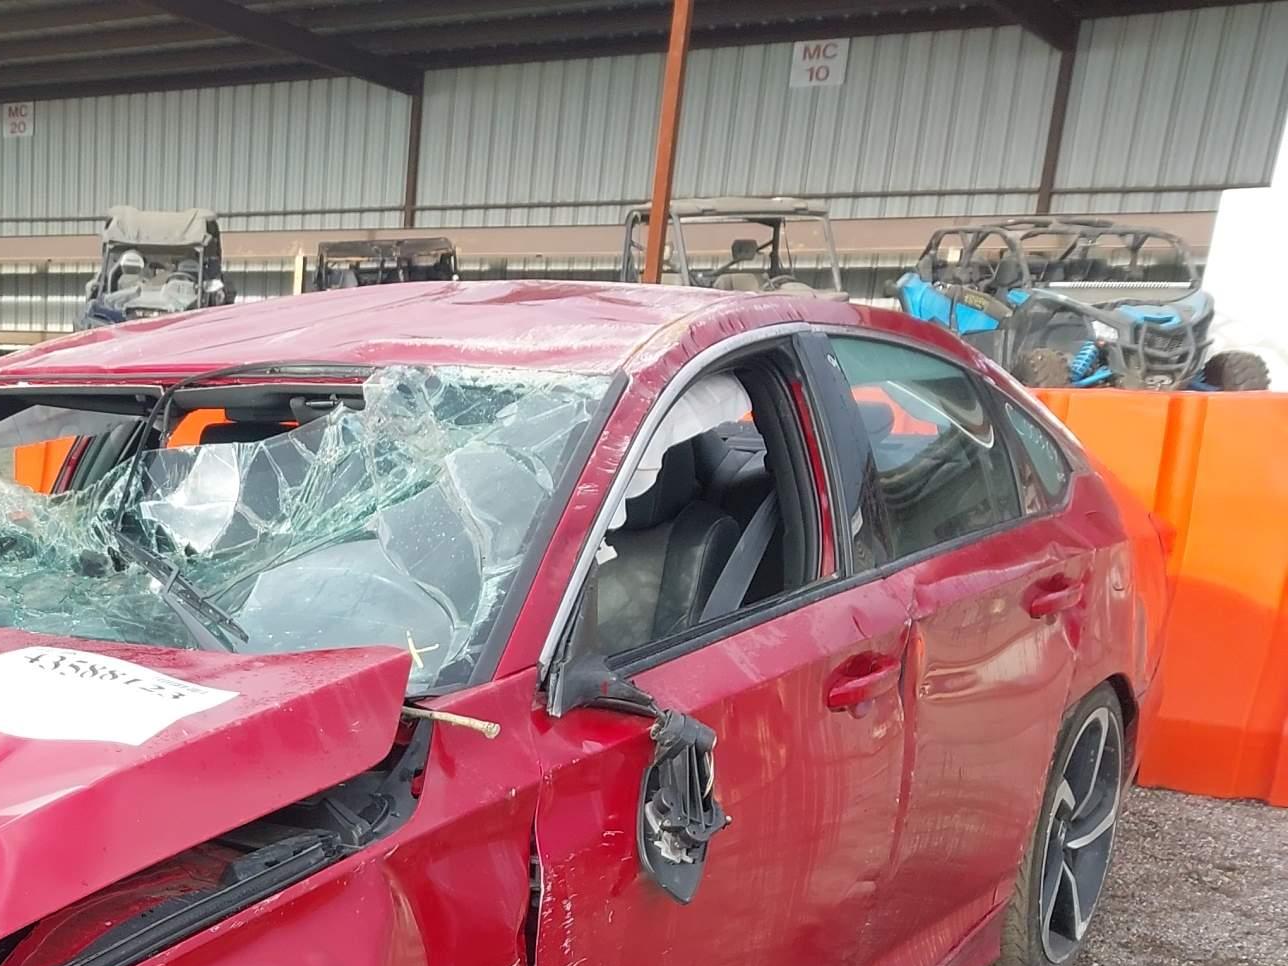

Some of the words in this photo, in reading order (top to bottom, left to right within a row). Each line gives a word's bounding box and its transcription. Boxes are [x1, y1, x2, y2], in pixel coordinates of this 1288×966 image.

[803, 43, 839, 61] MC
[807, 65, 830, 82] 10
[8, 104, 28, 118] MC
[10, 121, 26, 134] 20
